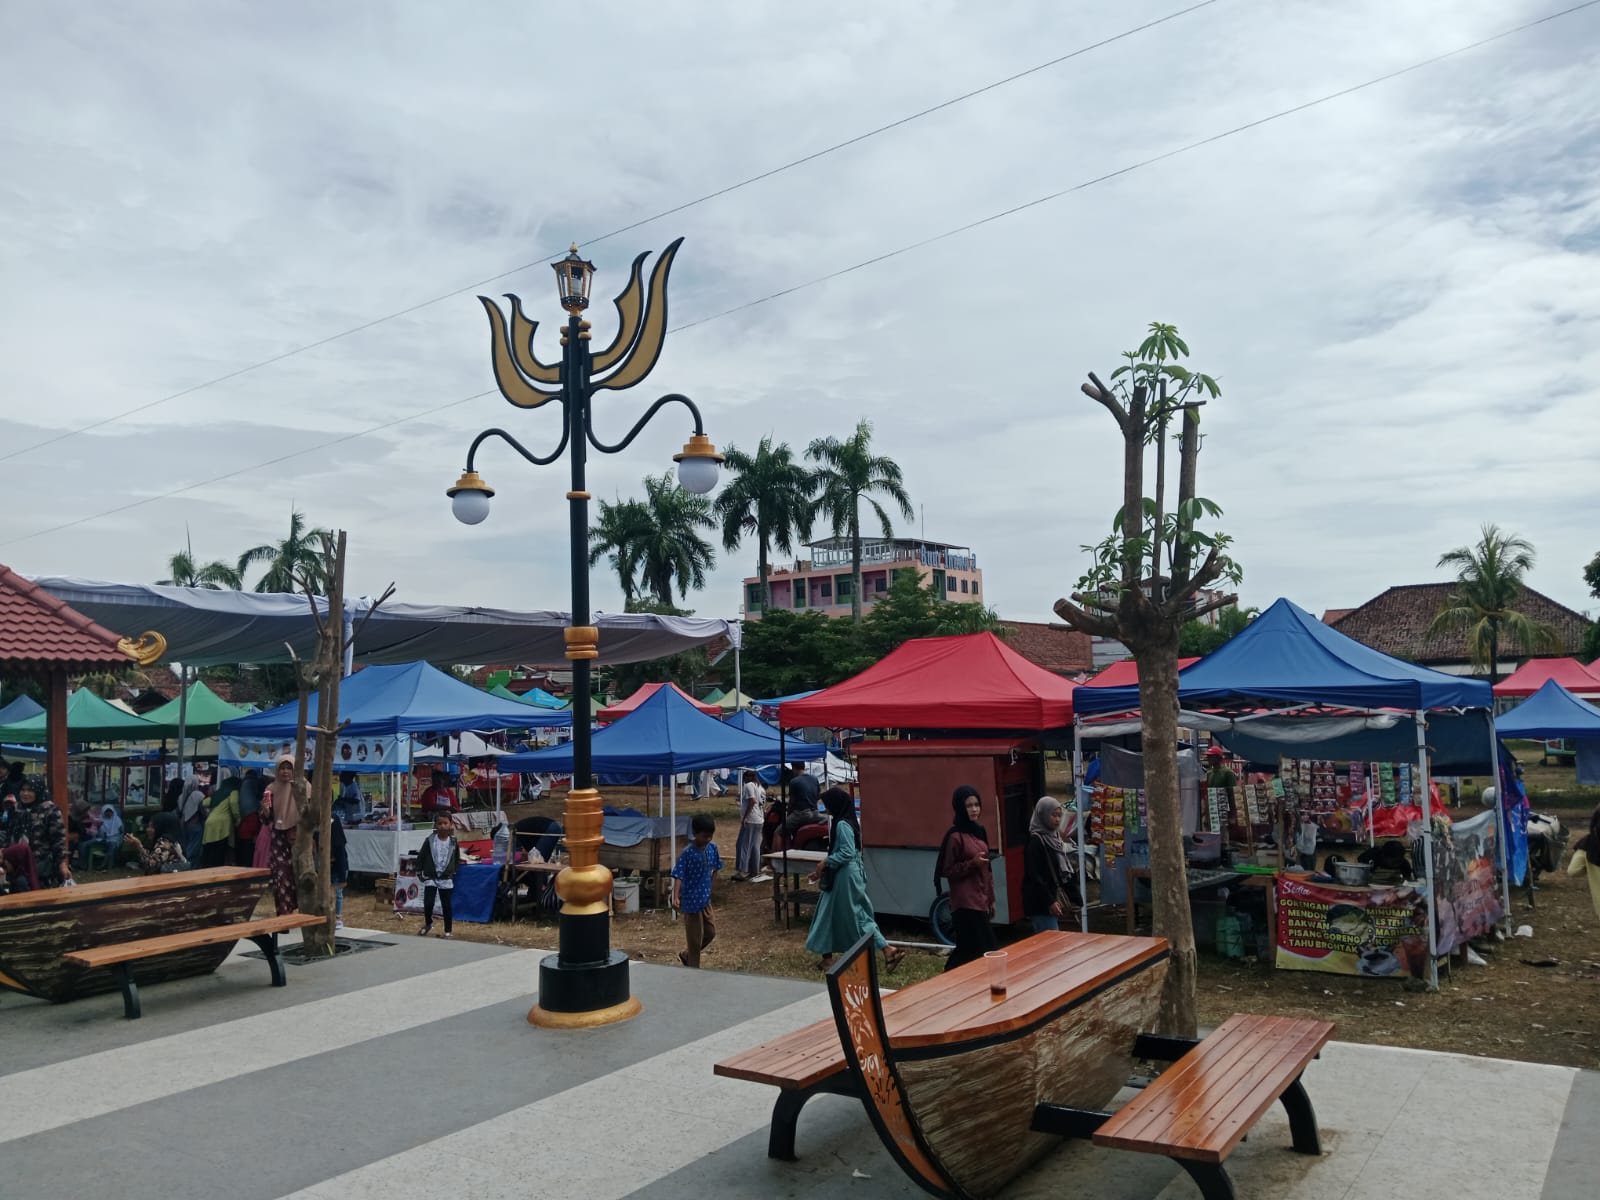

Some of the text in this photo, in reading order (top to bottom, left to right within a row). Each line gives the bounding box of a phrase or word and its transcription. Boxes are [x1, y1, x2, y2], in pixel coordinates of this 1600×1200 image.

[1280, 899, 1329, 911] GORENGAN
[1366, 908, 1415, 918] MINUMAN
[1288, 919, 1330, 930] BAKWAN
[1376, 918, 1386, 926] ES
[1288, 929, 1362, 944] PISANG GORENG
[1288, 939, 1314, 949] TAHU
